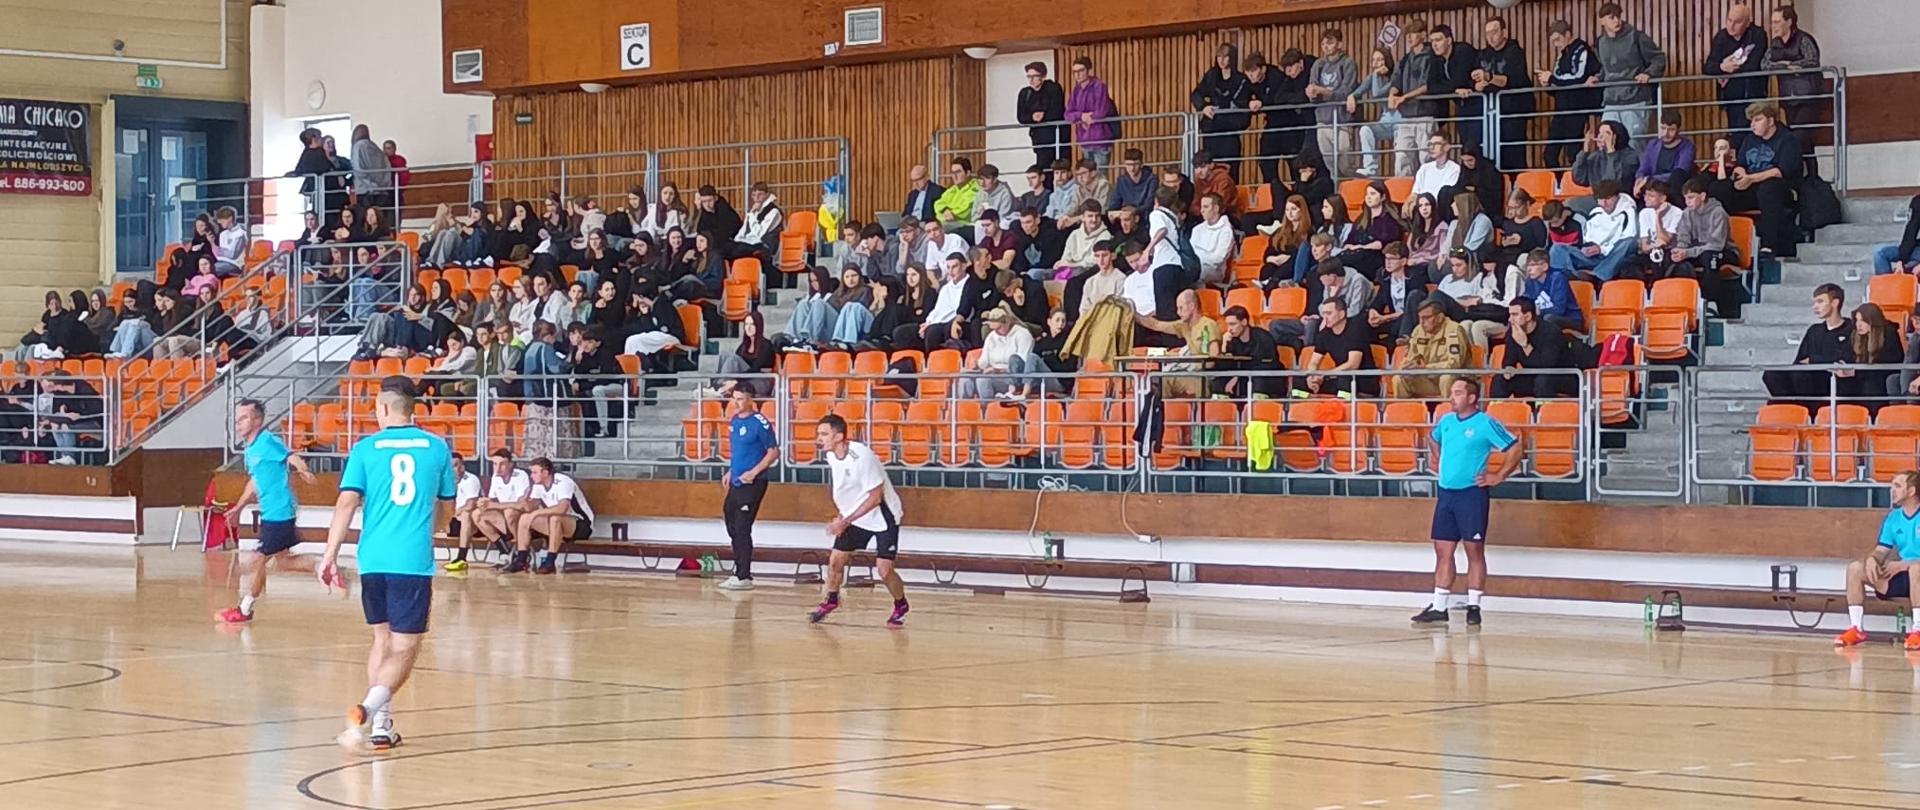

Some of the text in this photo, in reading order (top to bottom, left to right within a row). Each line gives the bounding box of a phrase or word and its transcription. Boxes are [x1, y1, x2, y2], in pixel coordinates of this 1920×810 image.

[627, 43, 644, 65] C
[14, 178, 85, 191] 886-993-600
[390, 453, 416, 506] 8
